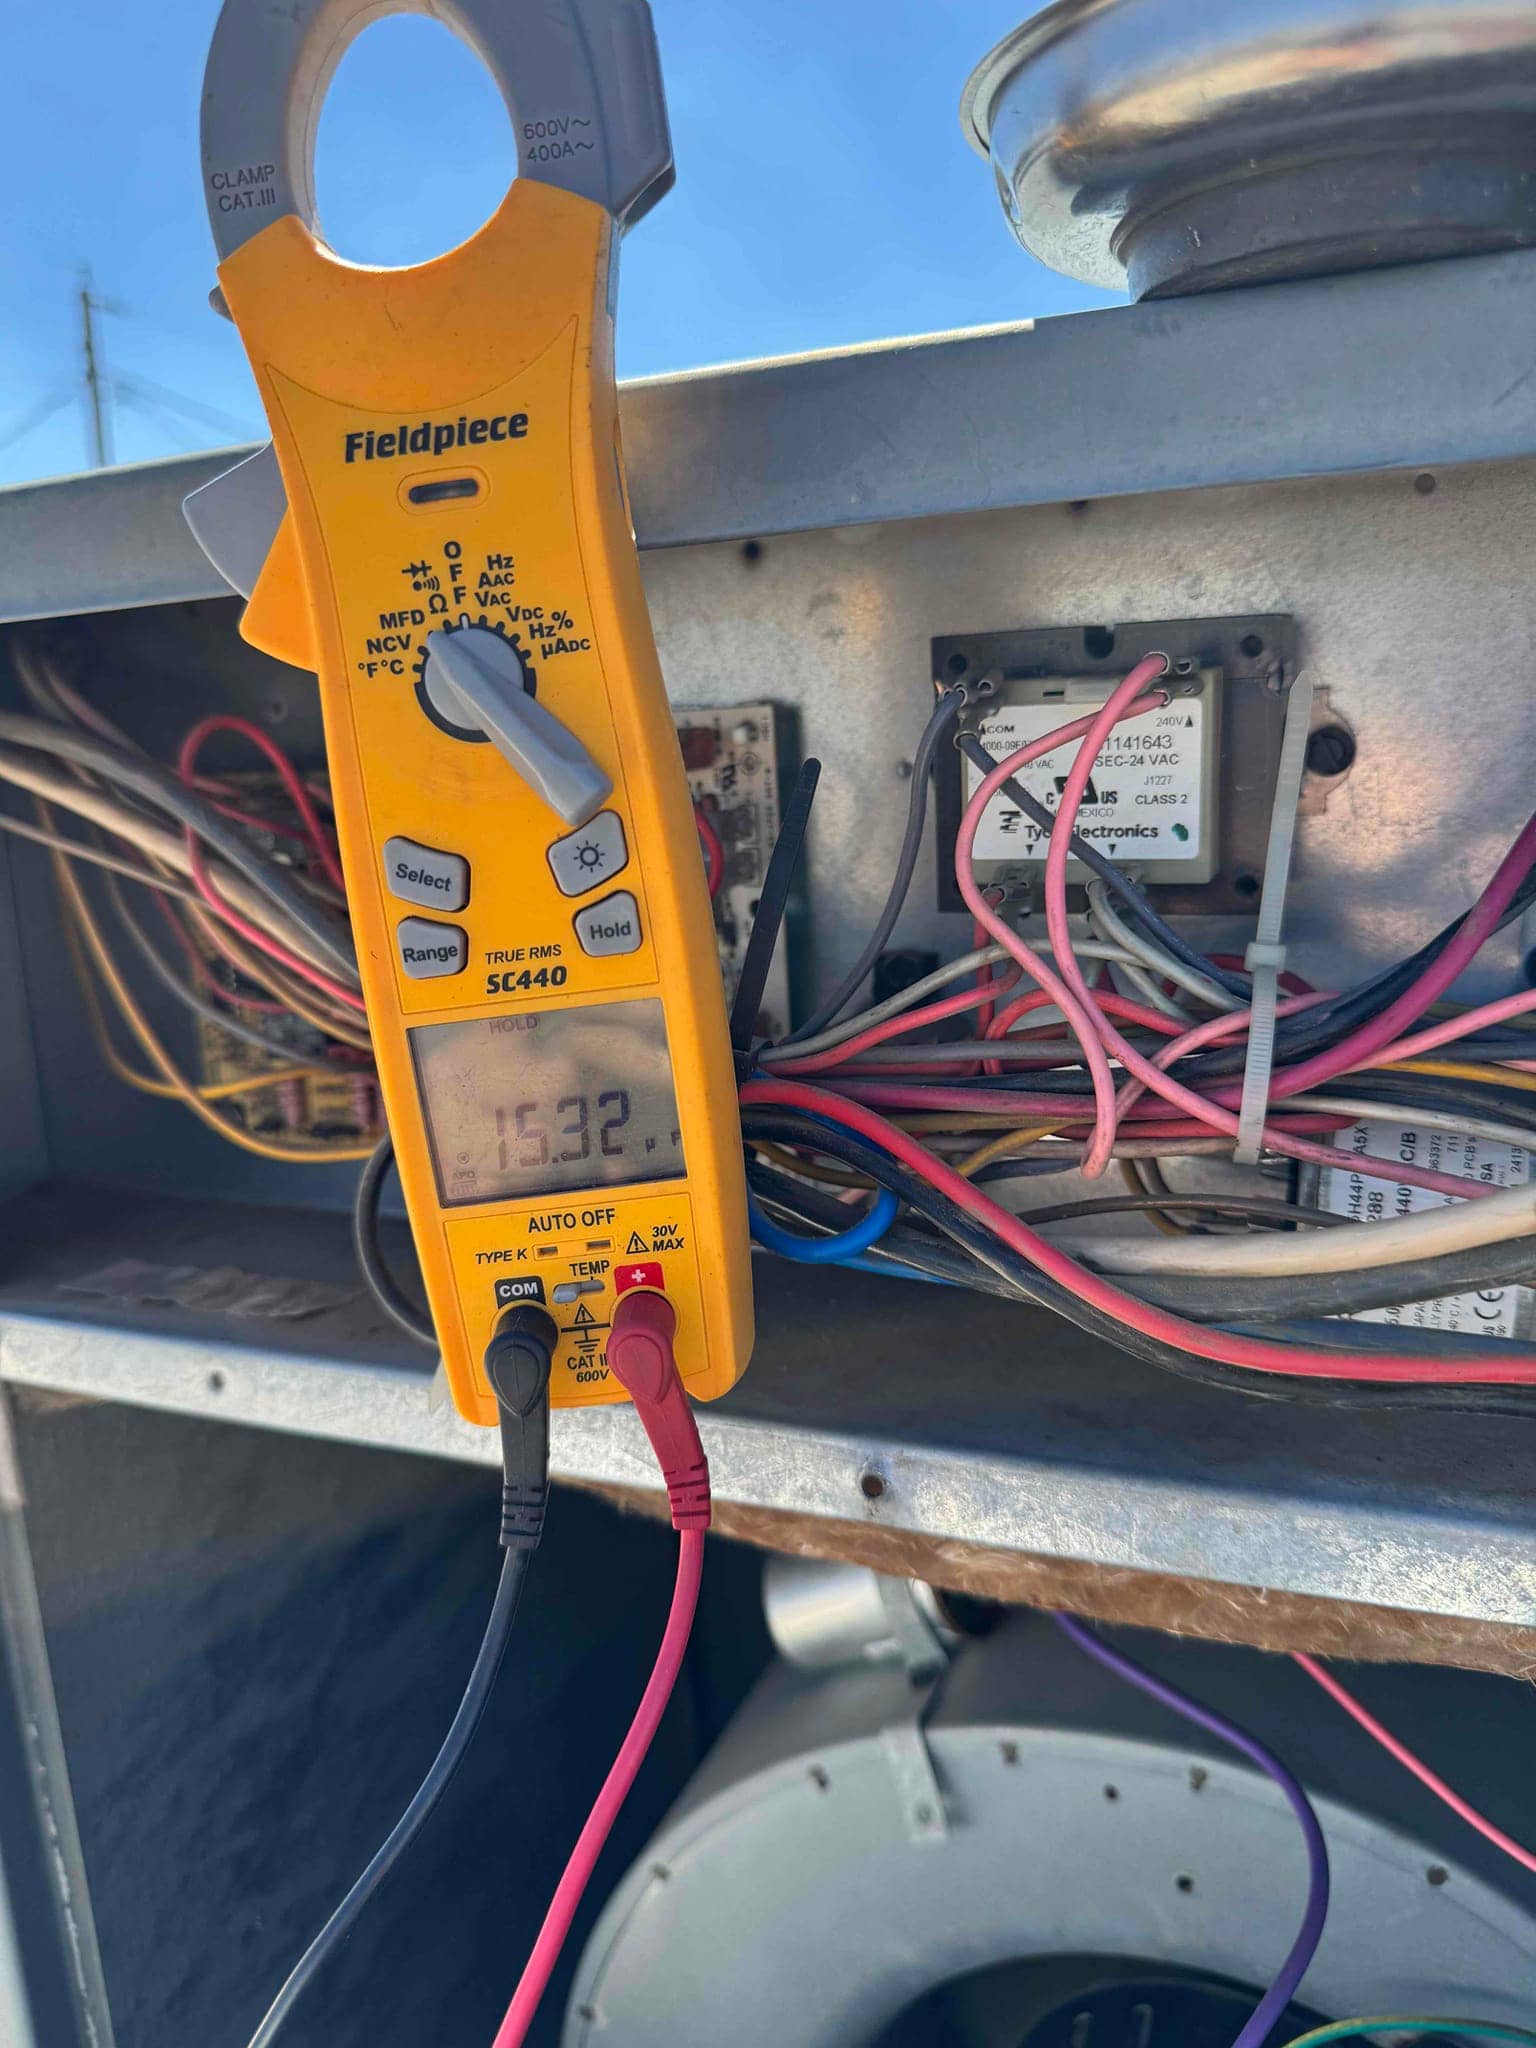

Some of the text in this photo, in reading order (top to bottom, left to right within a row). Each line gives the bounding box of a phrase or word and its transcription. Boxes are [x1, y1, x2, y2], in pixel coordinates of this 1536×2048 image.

[211, 164, 276, 191] CLAMP
[345, 413, 529, 464] Fieldpiece
[487, 554, 514, 571] Hz
[379, 608, 425, 630] MFD
[528, 623, 557, 640] Hz
[366, 634, 411, 655] NCV
[986, 724, 1015, 735] COM
[1156, 717, 1183, 728] 240V
[1094, 753, 1180, 768] SEC-24 VAC
[1100, 791, 1118, 805] US
[1135, 794, 1188, 806] CLASS 2
[1073, 823, 1159, 838] lectronics
[395, 863, 452, 892] Select
[590, 921, 632, 941] Hold
[402, 943, 458, 965] Range
[485, 944, 562, 965] TRUE RMS
[486, 965, 568, 995] SC440
[489, 1015, 539, 1035] HOLD
[495, 1089, 631, 1170] 15.32
[528, 1208, 616, 1233] AUTO OFF
[651, 1224, 678, 1237] 30V
[652, 1237, 685, 1252] MAX
[475, 1248, 528, 1265] TYPE K
[569, 1259, 610, 1277] TEMP
[499, 1282, 539, 1297] COM
[567, 1355, 596, 1371] CAT
[576, 1368, 610, 1384] 600V
